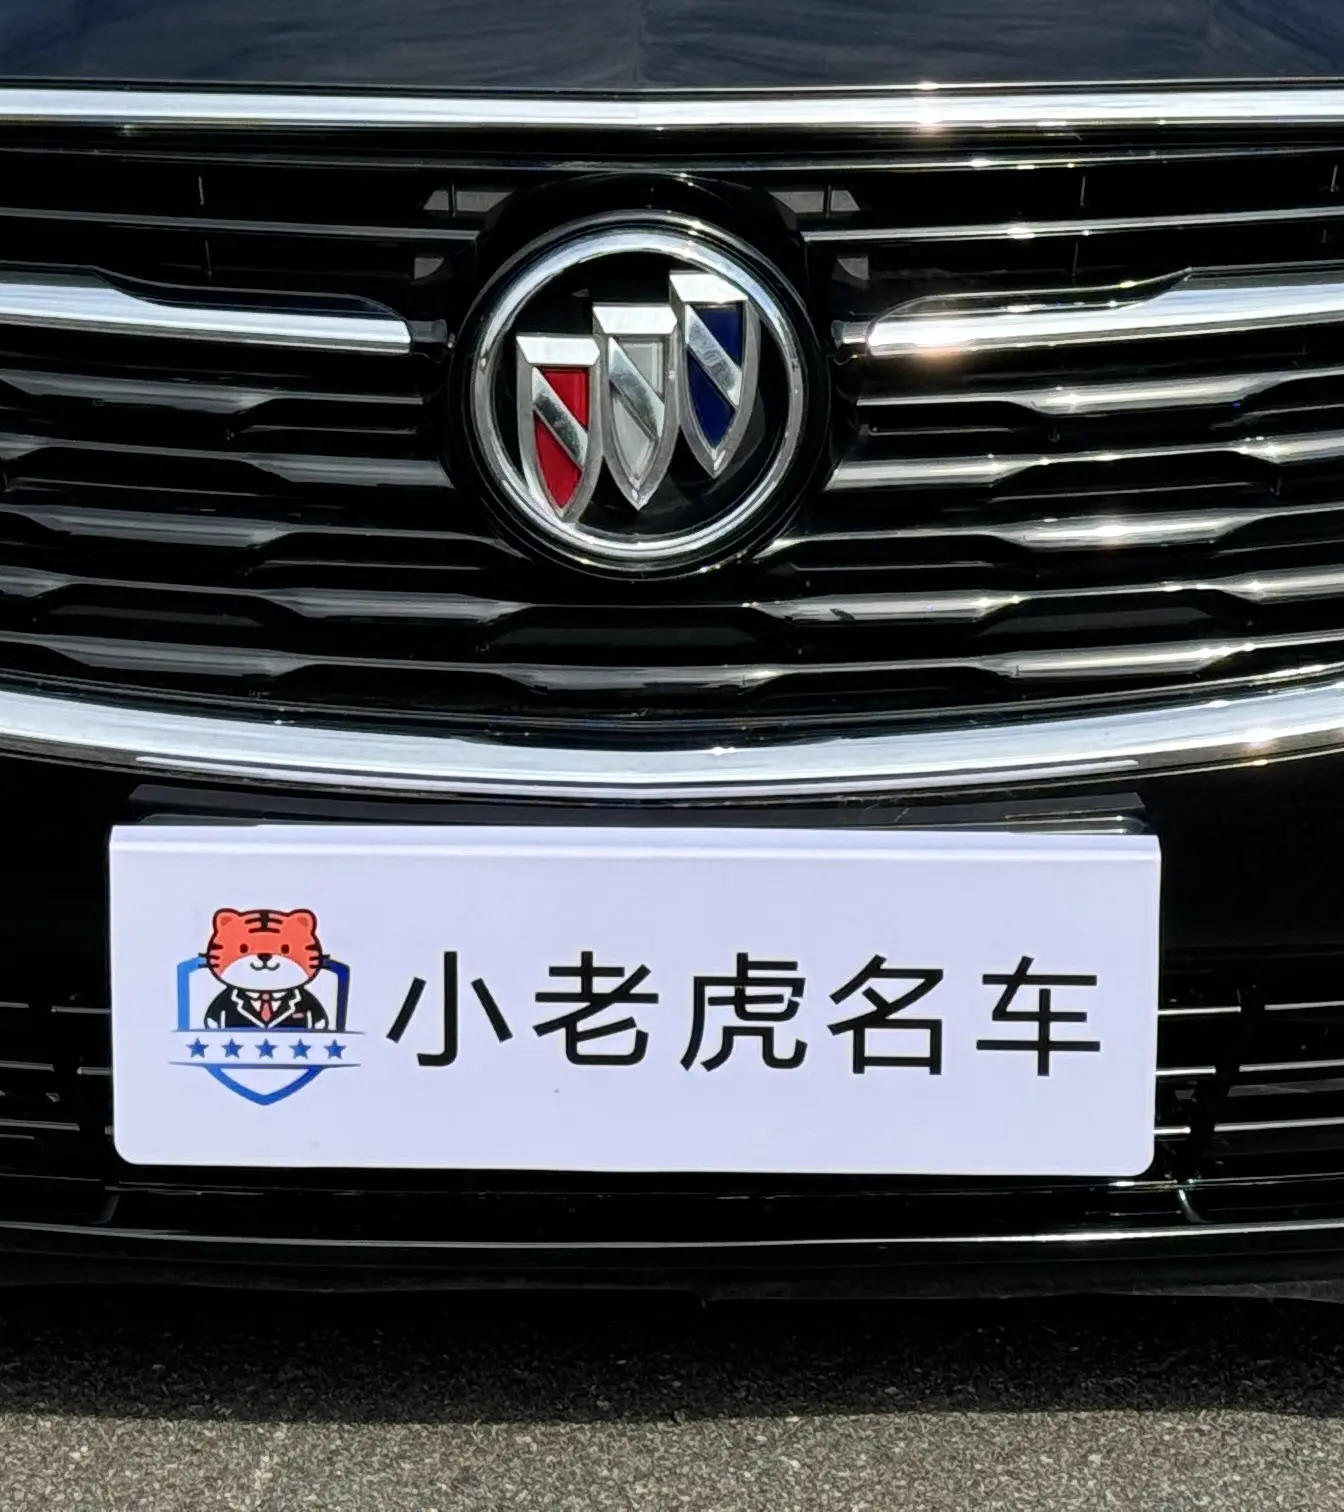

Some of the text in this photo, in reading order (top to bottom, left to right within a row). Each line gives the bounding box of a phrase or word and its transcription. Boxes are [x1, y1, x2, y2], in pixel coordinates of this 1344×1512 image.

[385, 950, 1100, 1076] 小老虎名车
